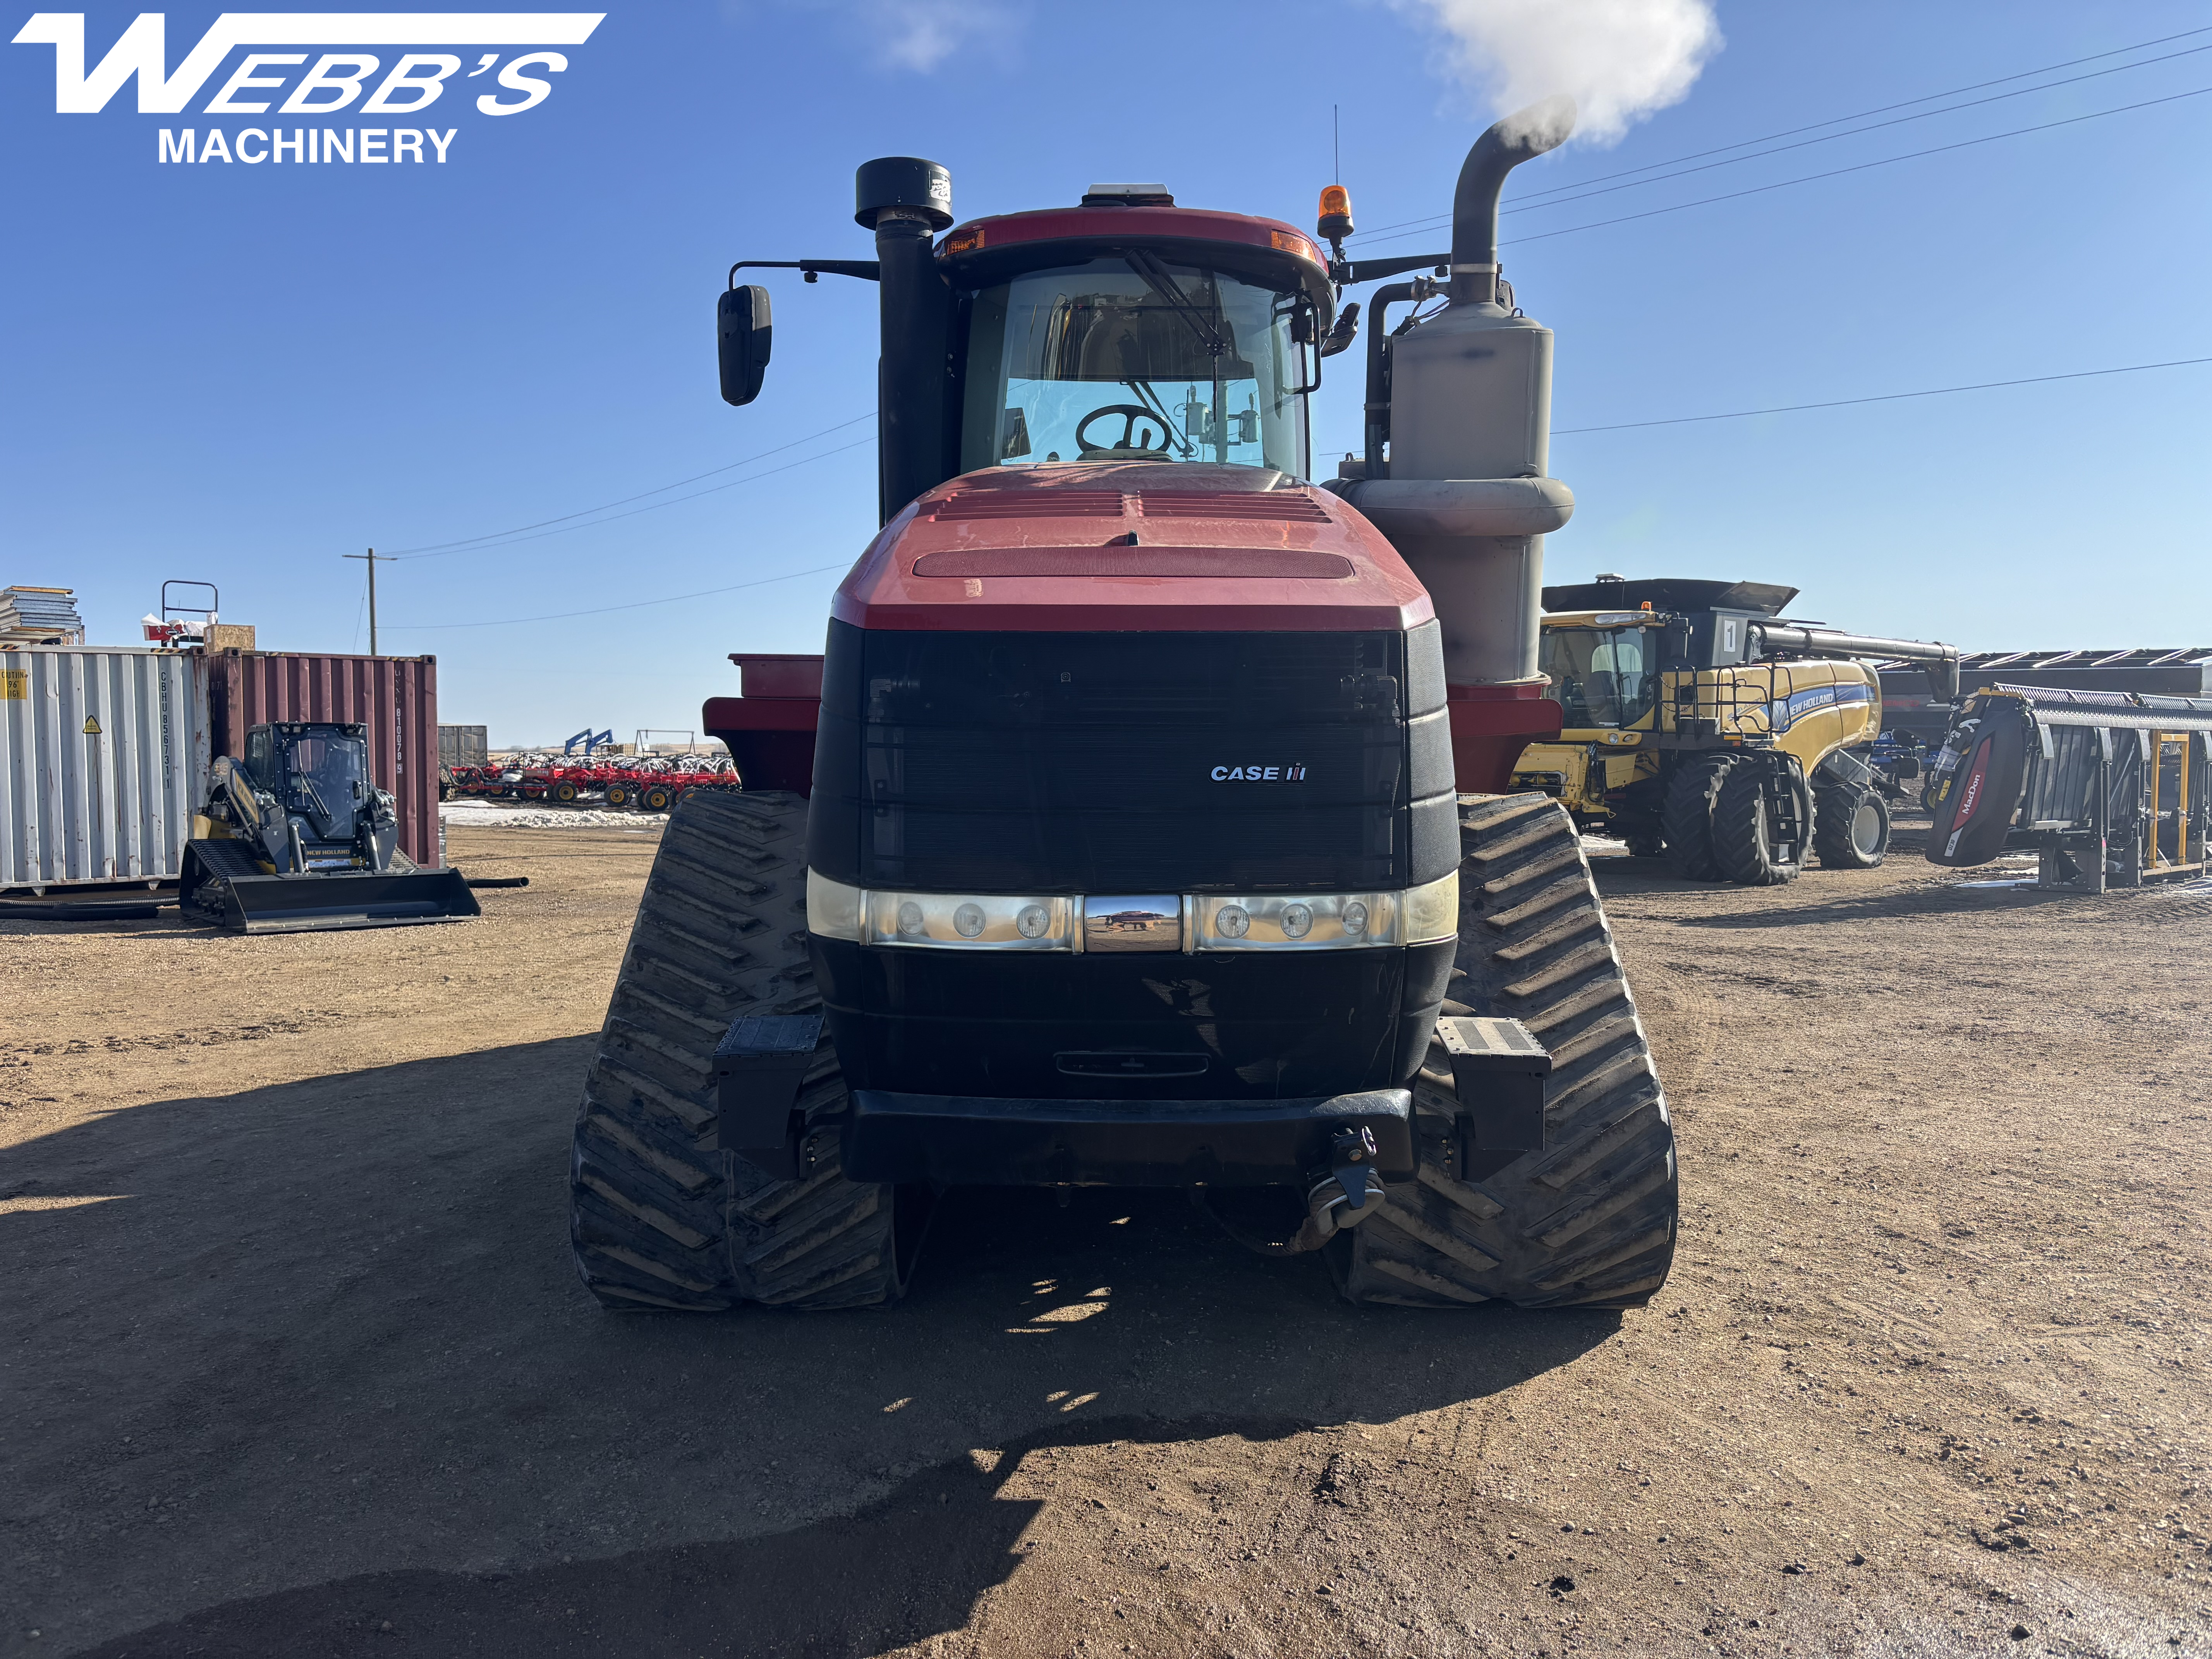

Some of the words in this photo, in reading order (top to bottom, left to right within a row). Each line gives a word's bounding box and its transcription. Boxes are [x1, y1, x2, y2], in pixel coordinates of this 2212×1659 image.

[1727, 625, 1733, 647] 1
[1803, 694, 1833, 710] HOLLAND
[397, 764, 402, 773] 9
[1211, 766, 1279, 781] CASE
[1962, 774, 1980, 814] MacDon
